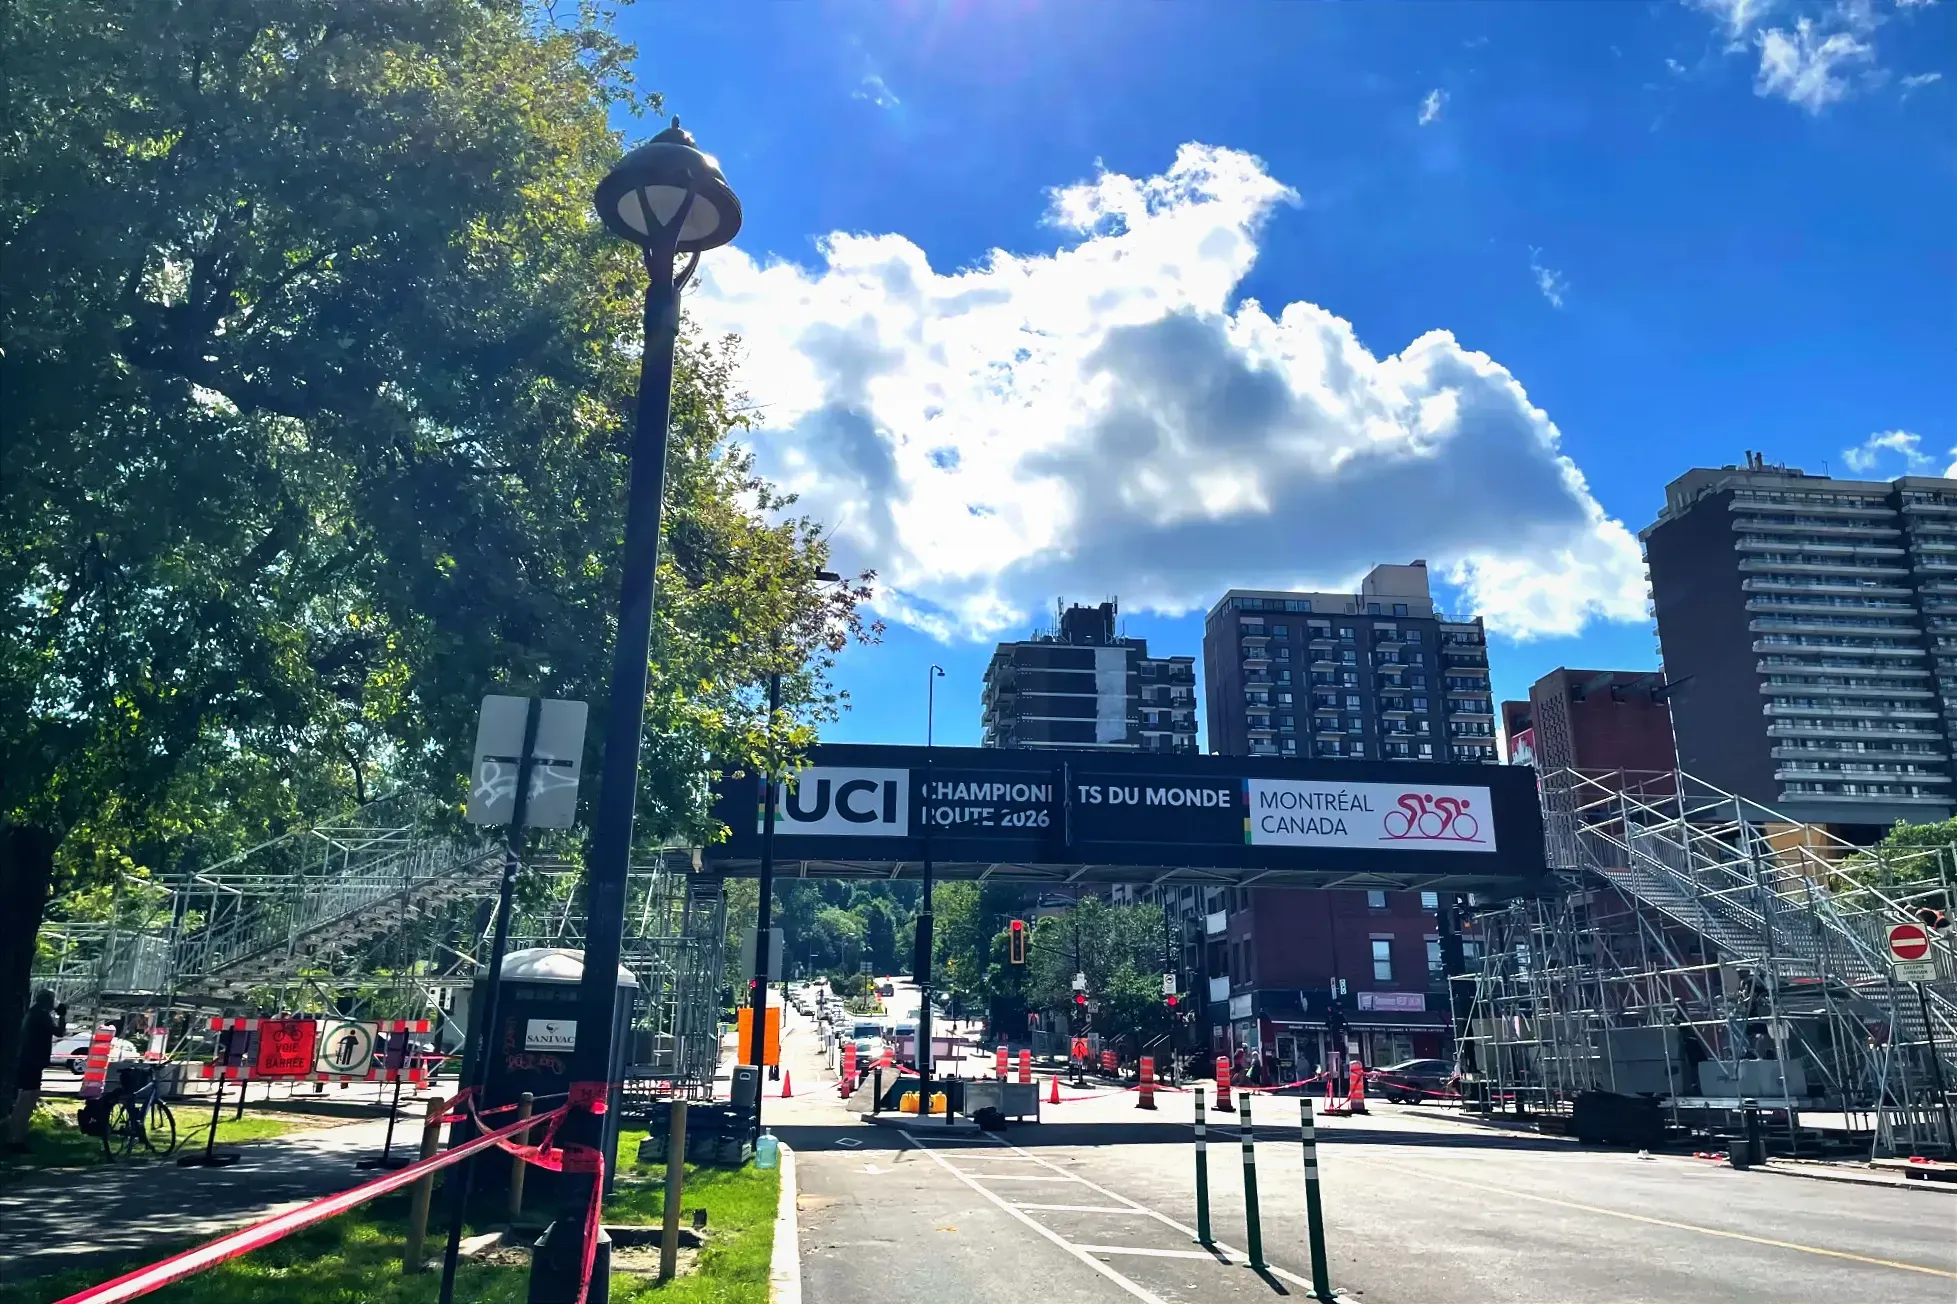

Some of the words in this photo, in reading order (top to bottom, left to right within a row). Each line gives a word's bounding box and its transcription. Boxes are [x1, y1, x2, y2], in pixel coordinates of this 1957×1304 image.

[785, 779, 898, 824] UCI
[1108, 786, 1139, 805] DU
[1145, 787, 1231, 808] MONDE
[1259, 790, 1375, 812] MONTRÉAL
[1000, 808, 1051, 828] 2026
[1260, 815, 1348, 836] CANADA
[276, 1043, 299, 1053] VOIE
